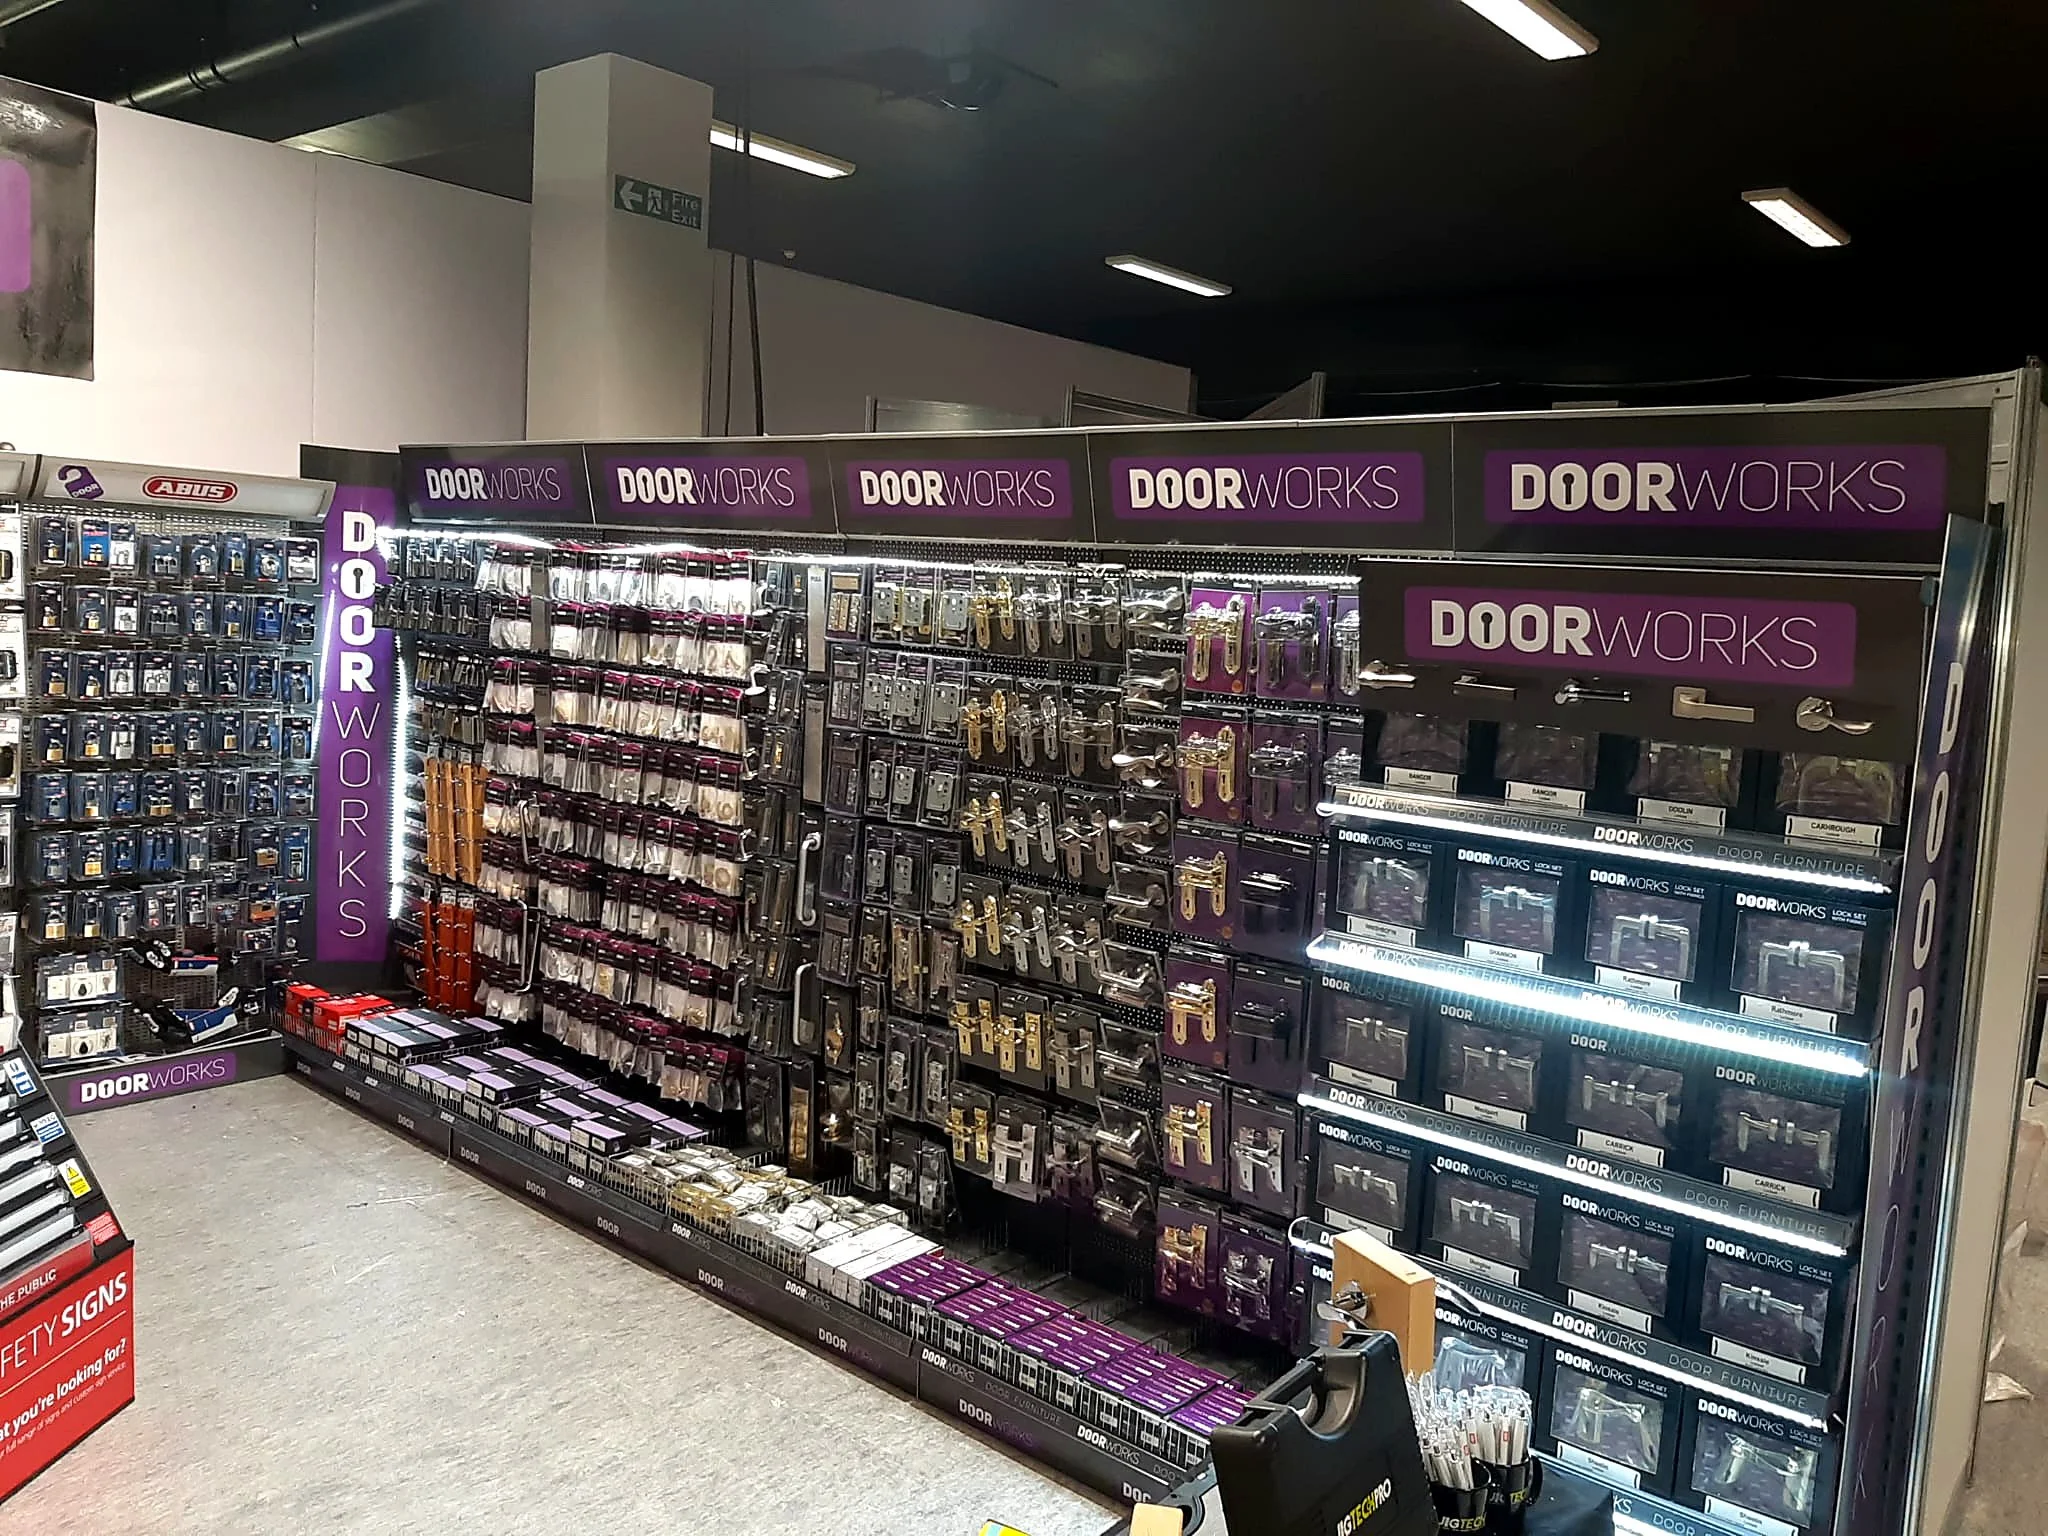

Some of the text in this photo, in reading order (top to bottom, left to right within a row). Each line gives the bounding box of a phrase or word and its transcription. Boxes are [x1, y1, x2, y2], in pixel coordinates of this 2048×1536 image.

[671, 209, 697, 227] Exit
[672, 192, 698, 210] Fire
[154, 480, 228, 500] ABUS
[425, 466, 561, 501] DOORWORKS
[617, 466, 795, 507] DOORWORKS
[860, 470, 1055, 508] DOORWORKS
[1129, 465, 1400, 510] DOORWORKS
[1511, 460, 1906, 514] DOORWORKS
[1431, 599, 1818, 671] DOORWORKS
[330, 510, 381, 938] DOORWORKS
[1449, 809, 1487, 826] DOOR
[1493, 814, 1568, 834] FURNITURE
[1338, 829, 1403, 851] DOORWORKS
[1593, 826, 1866, 876] DOORWORKS DOOR FURNITURE
[1458, 849, 1530, 871] DOORWORKS
[1590, 869, 1669, 894] DOORWORKS
[1736, 893, 1827, 919] DOORWORKS
[1703, 1019, 1747, 1037] DOOR
[81, 1057, 226, 1103] DOORWORKS
[1319, 1122, 1382, 1151] DOORWORKS
[1329, 1087, 1541, 1156] DOORWORKS DOOR FURNITURE
[1436, 1155, 1507, 1186] DOORWORKS
[1754, 1178, 1786, 1192] CARRICK
[1562, 1193, 1640, 1228] DOORWORKS
[1566, 1153, 1829, 1236] DOORWORKS DOOR FURNITURE
[1706, 1237, 1793, 1273] DOORWORKS
[16, 1269, 56, 1298] PUBLIC
[61, 1271, 127, 1337] SIGNS
[1435, 1307, 1497, 1339] OORWORKS
[921, 1347, 976, 1384] DOORWORKS
[1552, 1311, 1806, 1408] DOORWORKS DOOR FURNITURE
[1555, 1348, 1634, 1387] DOORWORKS
[13, 1393, 54, 1437] you're
[56, 1359, 103, 1400] looking
[104, 1338, 127, 1365] for?
[1699, 1398, 1784, 1437] DOORWORKS
[1076, 1424, 1180, 1483] DOORWORKS DOO
